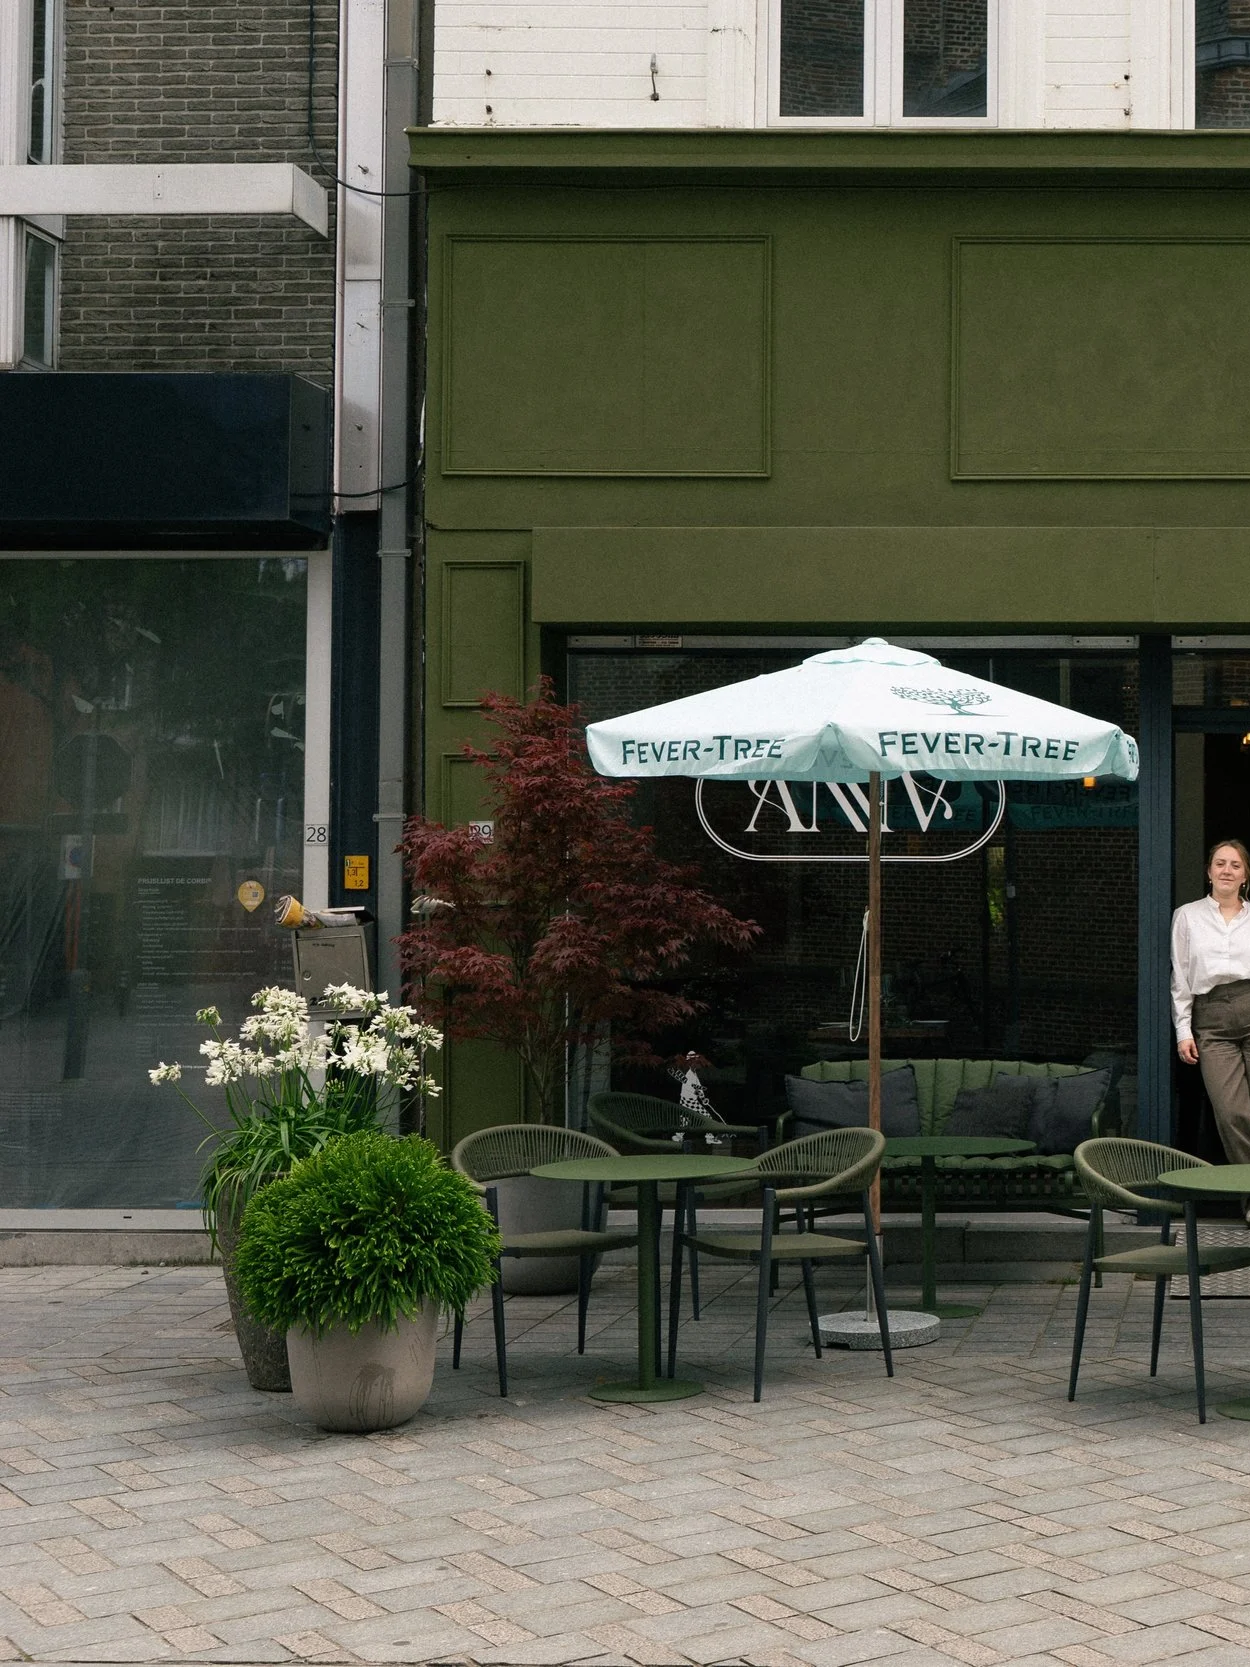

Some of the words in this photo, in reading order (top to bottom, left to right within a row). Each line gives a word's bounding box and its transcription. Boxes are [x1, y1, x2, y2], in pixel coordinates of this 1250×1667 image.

[622, 735, 786, 765] FEVER-TREE
[878, 731, 1080, 761] FEVER-TREE
[306, 827, 326, 842] 28
